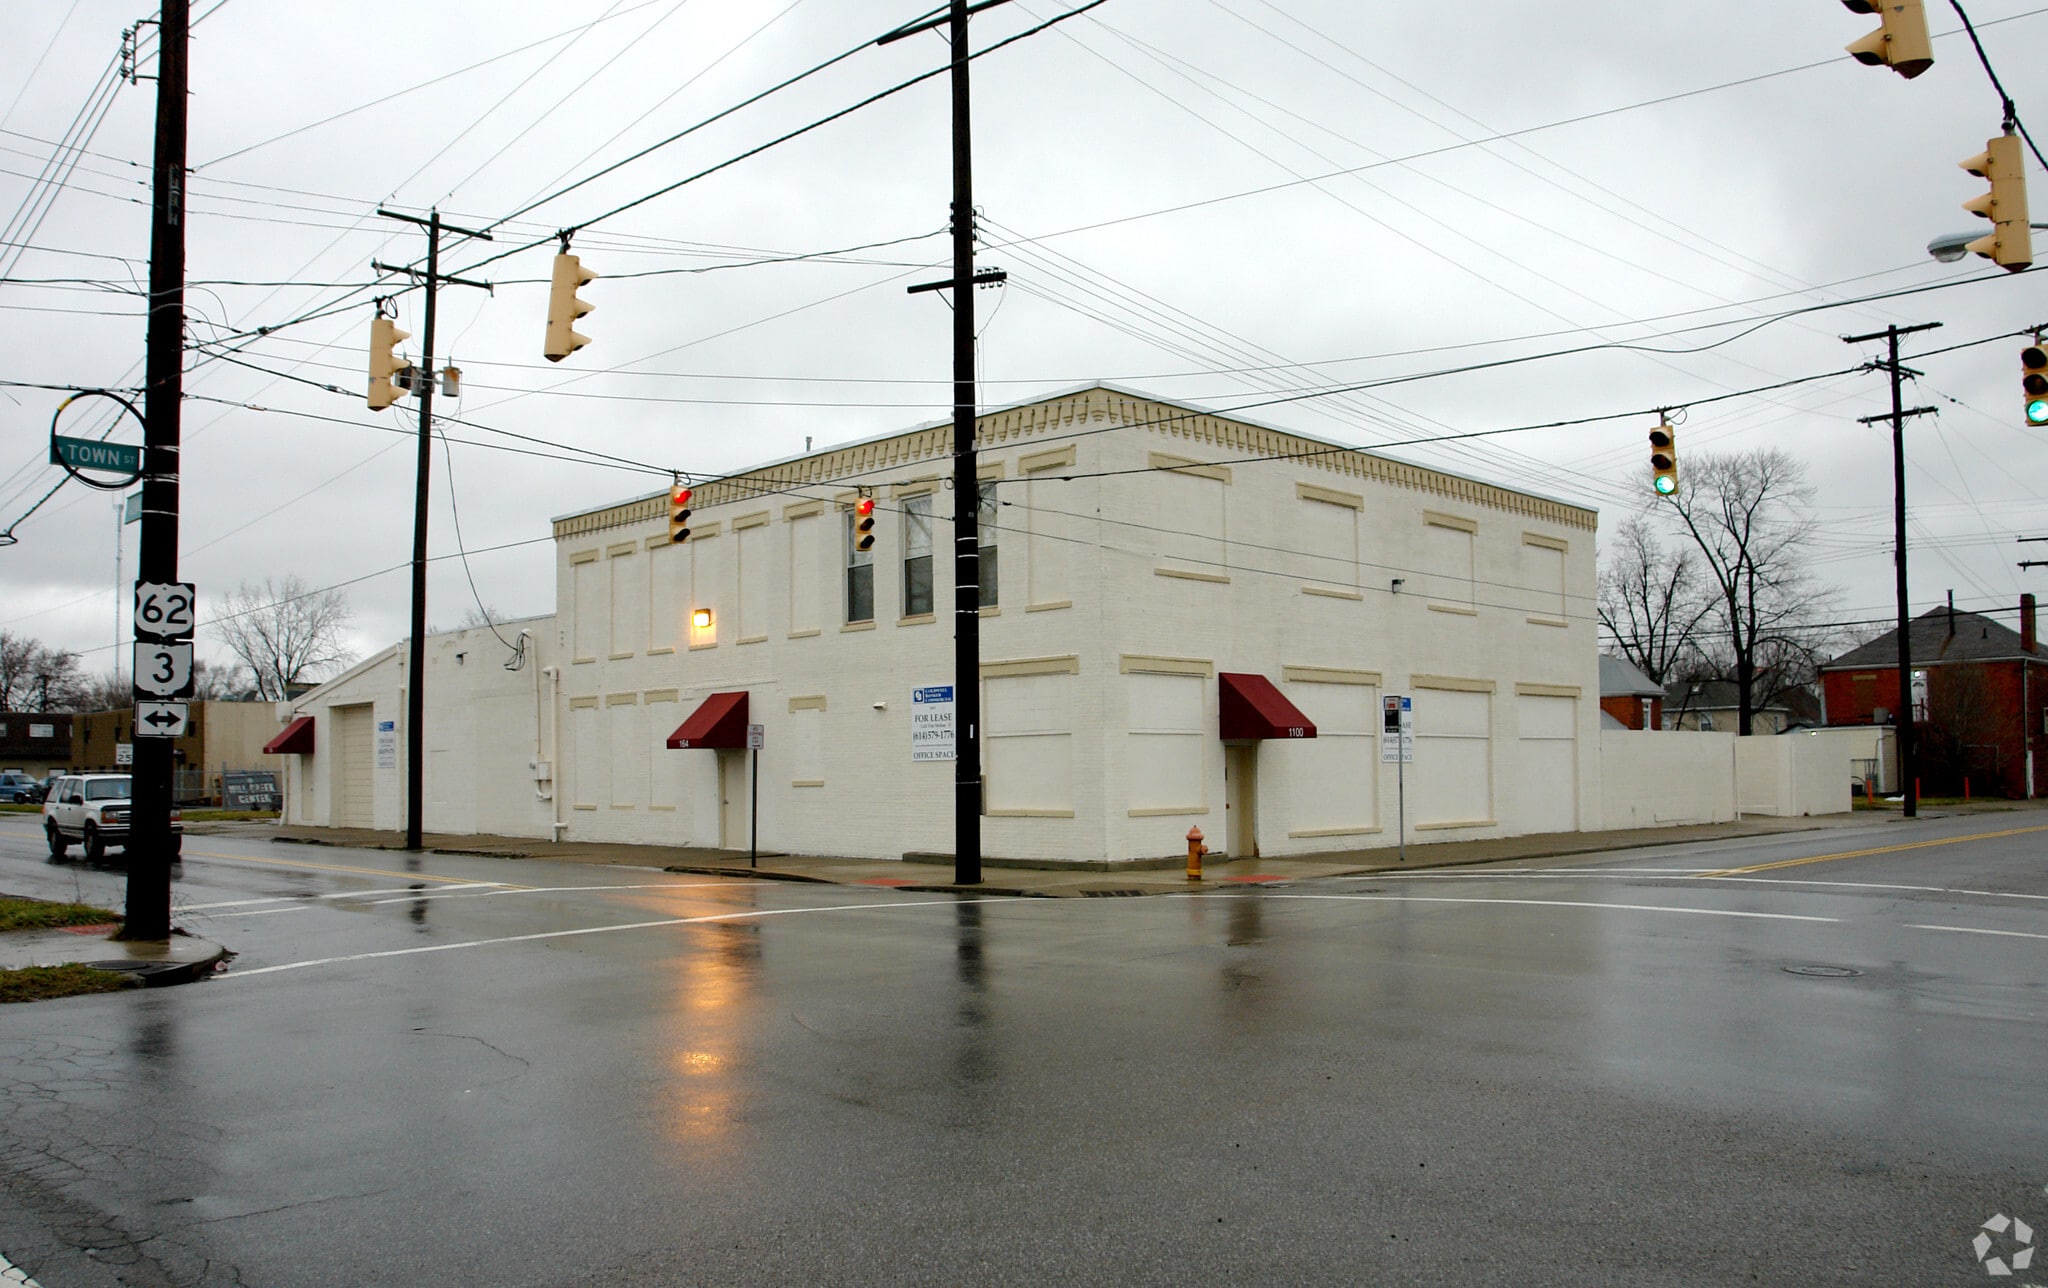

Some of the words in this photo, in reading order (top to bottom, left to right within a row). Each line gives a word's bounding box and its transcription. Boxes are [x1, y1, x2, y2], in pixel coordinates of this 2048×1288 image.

[68, 444, 119, 466] TOWN
[123, 455, 136, 464] ST
[142, 594, 188, 624] 62
[152, 652, 174, 683] 3
[914, 714, 929, 723] FOR
[930, 713, 952, 722] LEASE
[1288, 727, 1304, 737] 1100
[935, 751, 954, 759] SPACE
[238, 794, 272, 803] CENTER
